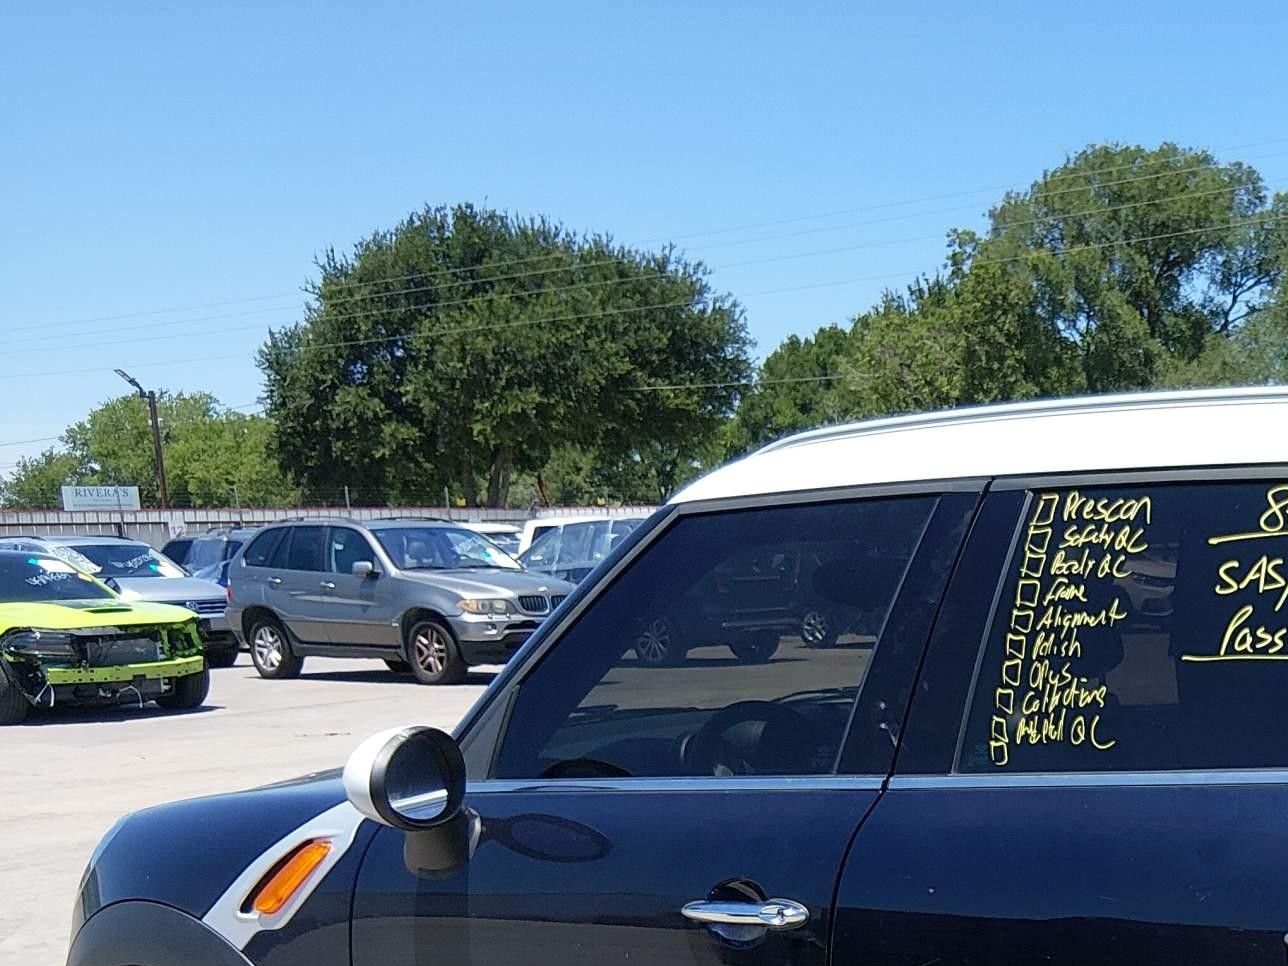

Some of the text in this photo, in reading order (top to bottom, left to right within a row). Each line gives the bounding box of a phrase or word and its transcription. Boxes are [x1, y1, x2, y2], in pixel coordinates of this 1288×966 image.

[74, 487, 129, 497] RIVERA'S
[1063, 490, 1150, 524] Prescan
[1114, 526, 1148, 552] QC
[1098, 554, 1132, 578] QC
[1035, 597, 1128, 640] Alignment
[1070, 714, 1117, 749] QC
